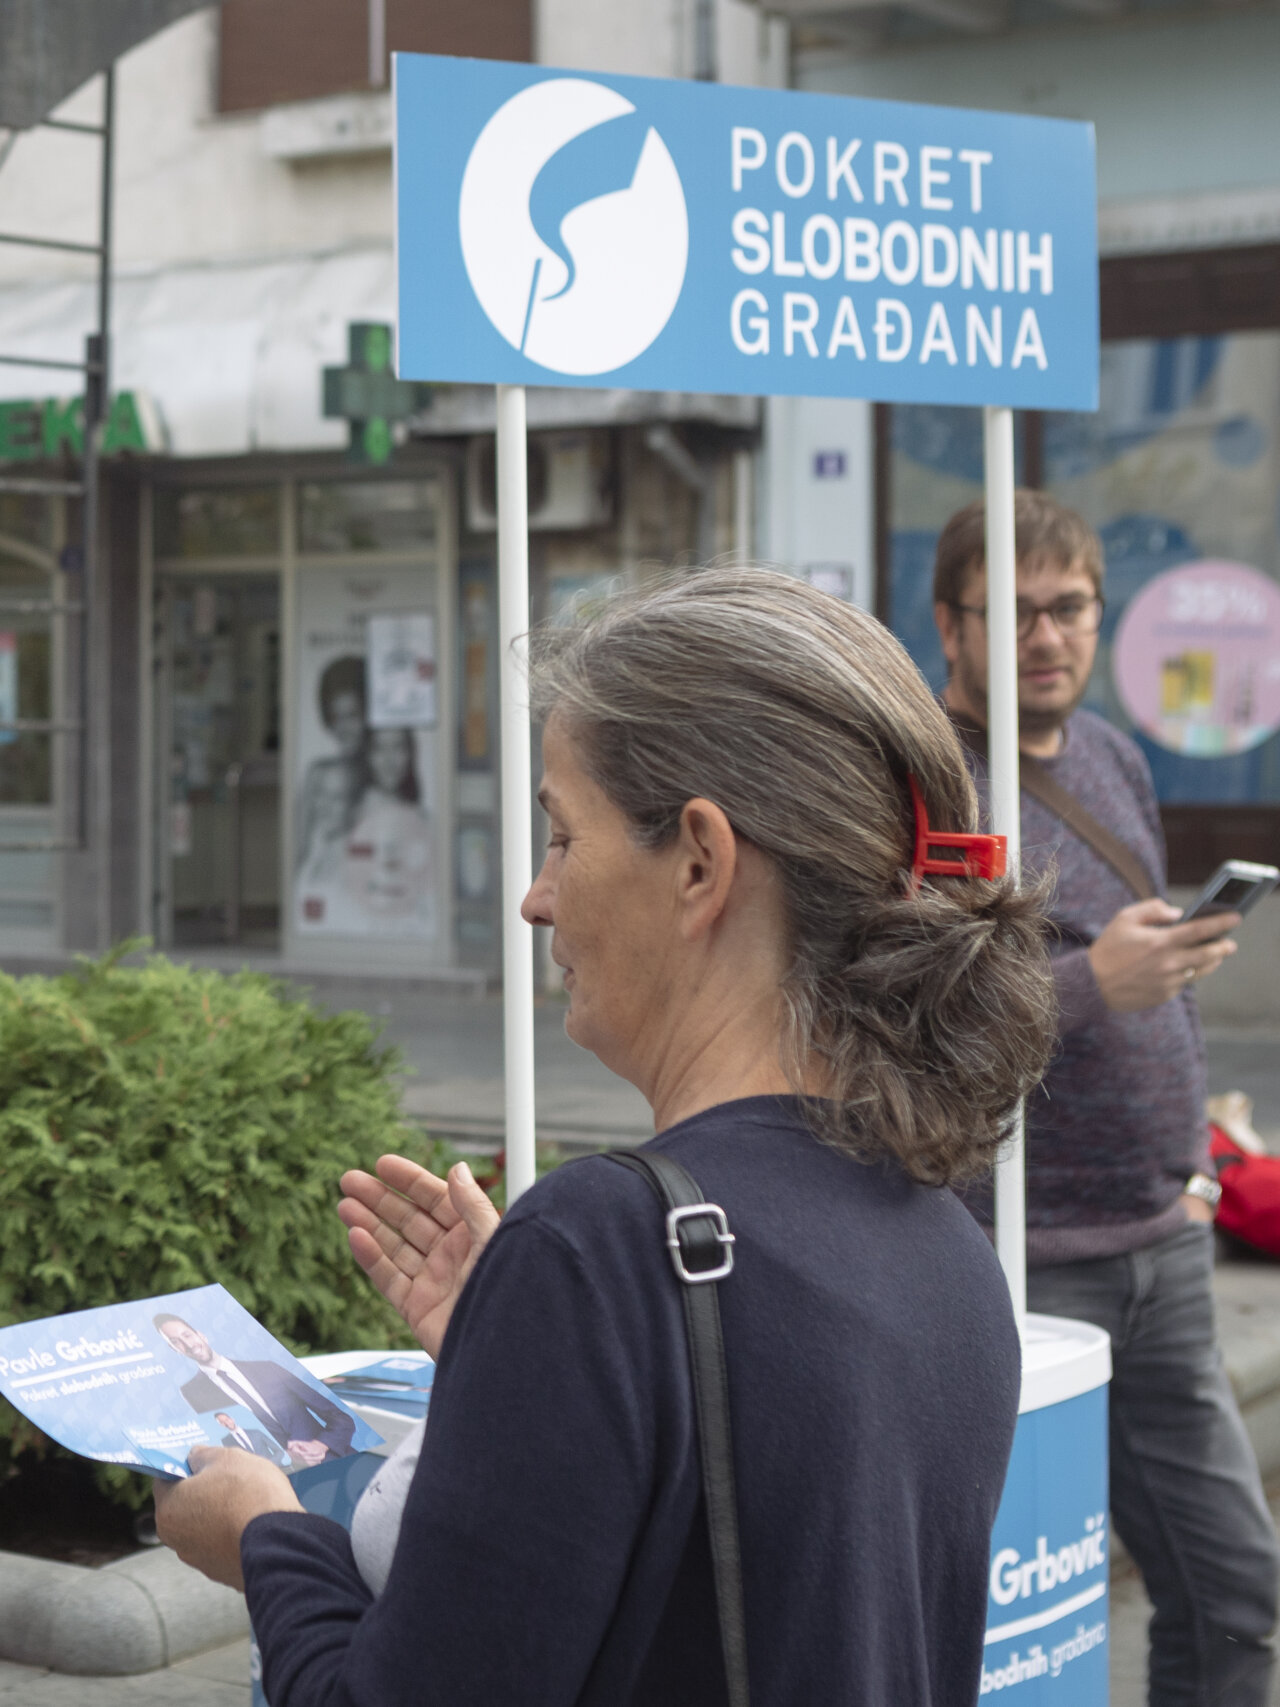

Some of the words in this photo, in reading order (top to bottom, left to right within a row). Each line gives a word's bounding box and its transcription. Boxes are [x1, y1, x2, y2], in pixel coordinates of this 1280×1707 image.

[731, 126, 993, 213] POKRET
[730, 208, 1054, 295] SLOBODNIH
[730, 289, 1049, 372] GRAĐANA
[55, 1328, 144, 1362] Grbović
[60, 1371, 118, 1396] slobodnih
[990, 1512, 1105, 1606] Grbović
[979, 1644, 1048, 1696] bodnih
